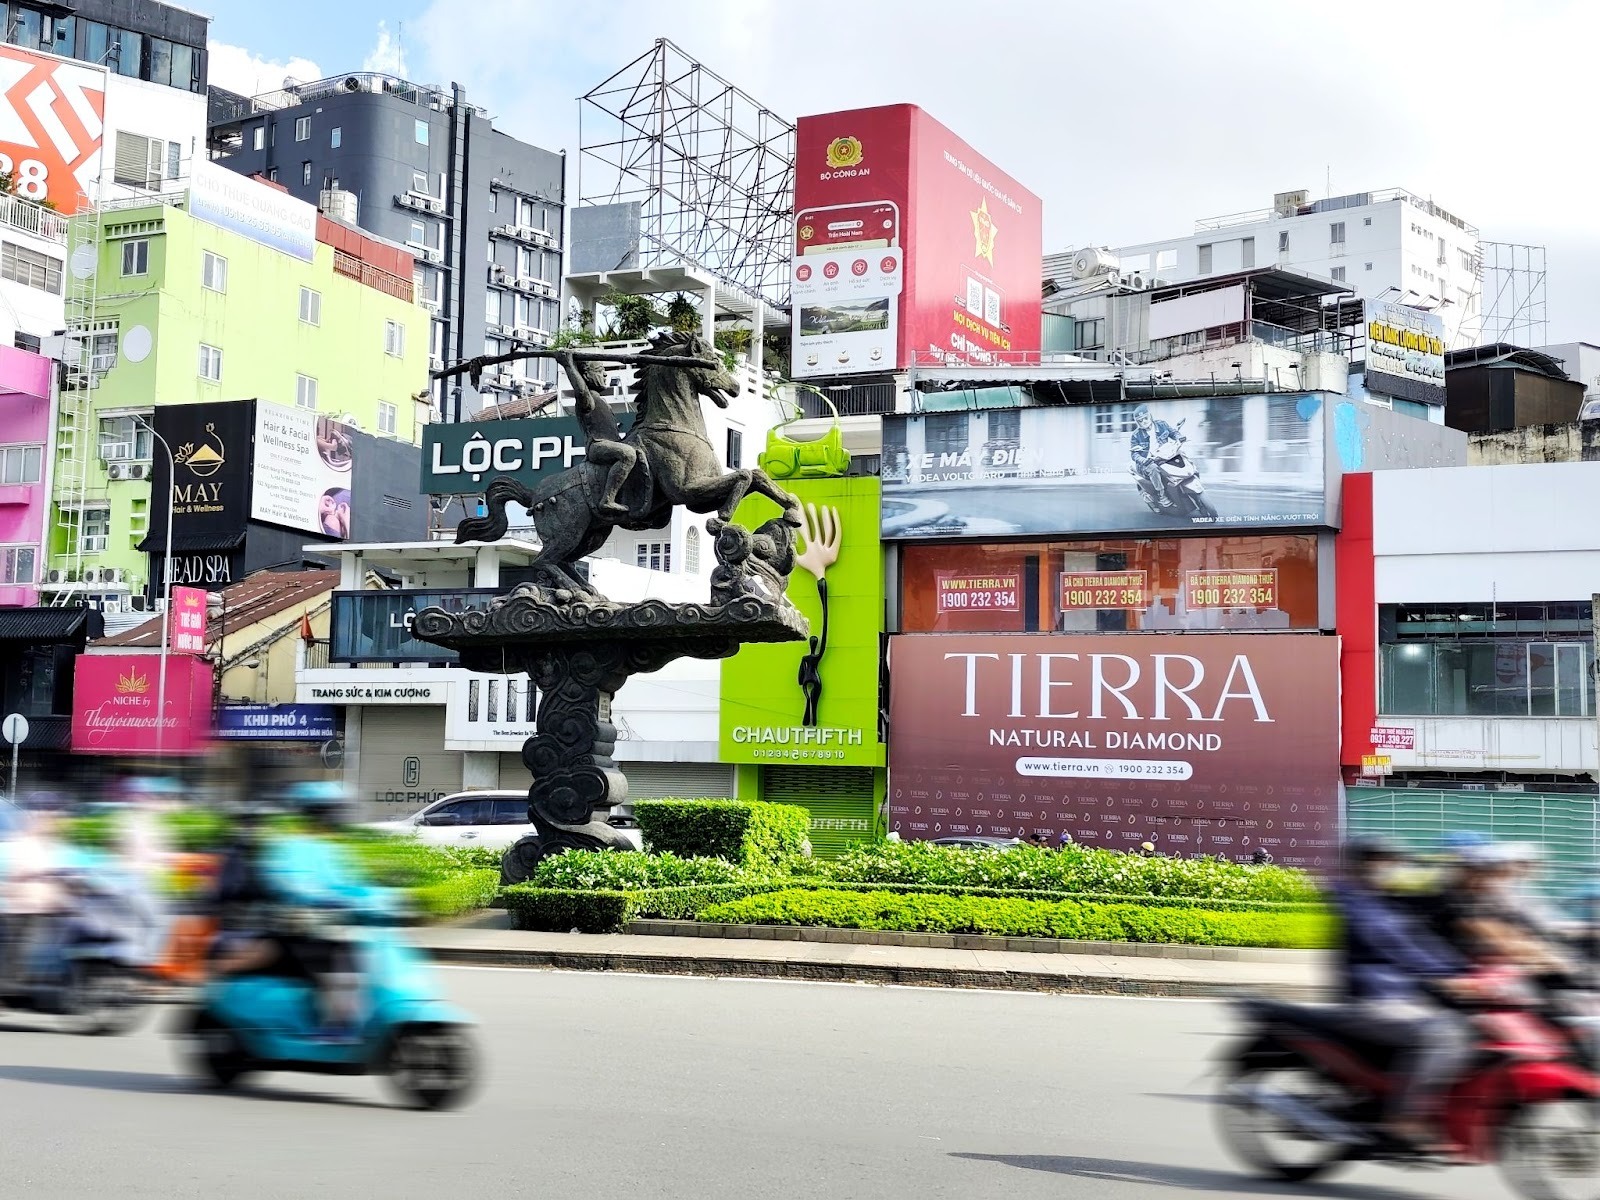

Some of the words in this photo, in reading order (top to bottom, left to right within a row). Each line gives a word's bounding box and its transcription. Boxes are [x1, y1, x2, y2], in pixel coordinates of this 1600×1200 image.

[820, 172, 831, 181] BỘ
[833, 169, 857, 179] CÔNG
[858, 168, 870, 176] AN
[966, 318, 981, 335] DỊCH
[263, 420, 279, 433] Hair
[281, 425, 288, 435] &
[290, 427, 311, 442] Facial
[263, 433, 295, 451] Wellness
[297, 443, 310, 455] Spa
[432, 430, 523, 482] LỘC
[532, 435, 586, 470] PH
[906, 453, 935, 469] XE
[174, 482, 224, 503] MAY
[172, 505, 186, 515] Hair
[186, 505, 192, 513] &
[193, 504, 224, 513] Wellness
[1244, 513, 1260, 522] TÍNH
[1261, 513, 1281, 521] NĂNG
[1282, 513, 1301, 521] VƯỢT
[1303, 513, 1319, 521] TRỘI
[163, 555, 203, 584] HEAD
[206, 555, 231, 583] SPA
[942, 578, 1015, 590] WWW.TIERRA.VN
[1064, 575, 1072, 587] ĐÃ
[1073, 577, 1084, 587] CHO
[1085, 576, 1103, 587] TIERRA
[1104, 576, 1129, 586] DIAMOND
[1190, 574, 1199, 586] ĐÃ
[1200, 576, 1211, 586] CHO
[1212, 575, 1232, 586] TIERRA
[1232, 574, 1258, 585] DIAMOND
[941, 592, 968, 608] 1900
[970, 592, 991, 607] 232
[994, 591, 1016, 606] 354
[1064, 590, 1092, 606] 1900
[1095, 589, 1117, 605] 232
[1120, 589, 1143, 604] 354
[1190, 589, 1220, 605] 1900
[1223, 588, 1246, 604] 232
[1249, 587, 1273, 603] 354
[390, 606, 417, 633] LỘ
[312, 688, 343, 698] TRANG
[345, 686, 364, 698] SỨC
[365, 688, 373, 698] &
[374, 688, 392, 698] KIM
[394, 688, 431, 698] CƯƠNG
[944, 653, 1276, 722] TIERRA
[113, 696, 141, 705] NICHE
[142, 696, 151, 708] by
[243, 714, 269, 727] KHU
[271, 709, 297, 727] PHỐ
[299, 714, 307, 727] 4
[284, 729, 297, 737] KHU
[297, 727, 309, 737] PHỐ
[732, 727, 862, 745] CHAUTFIFTH
[989, 728, 1096, 749] NATURAL
[1105, 731, 1222, 752] DIAMOND
[1370, 734, 1413, 745] 0931.339.227
[1024, 761, 1099, 772] www.tierra.vn
[1118, 764, 1143, 773] 1900
[1146, 765, 1164, 774] 232
[1166, 766, 1184, 774] 354
[375, 788, 405, 806] LỘC
[890, 805, 910, 813] TIERRA
[1235, 819, 1259, 827] TIERRA
[1167, 833, 1189, 841] TIERRA
[1211, 835, 1234, 843] TIERRA
[1283, 856, 1306, 864] TIERRA
